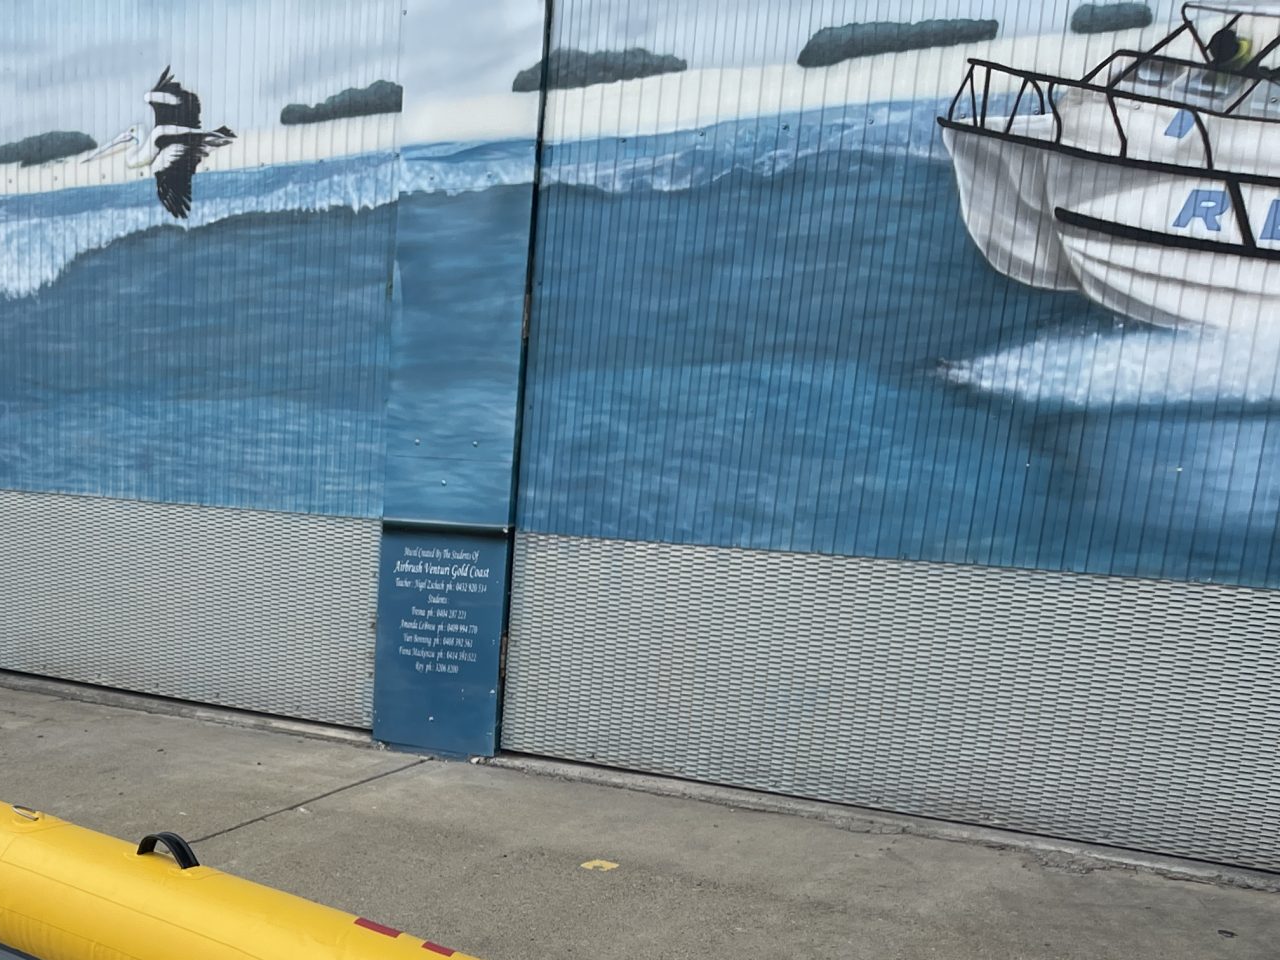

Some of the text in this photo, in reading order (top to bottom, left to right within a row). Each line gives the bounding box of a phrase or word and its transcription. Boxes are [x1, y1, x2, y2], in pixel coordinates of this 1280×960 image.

[393, 560, 490, 579] Airbrush Venturi Gold Coast
